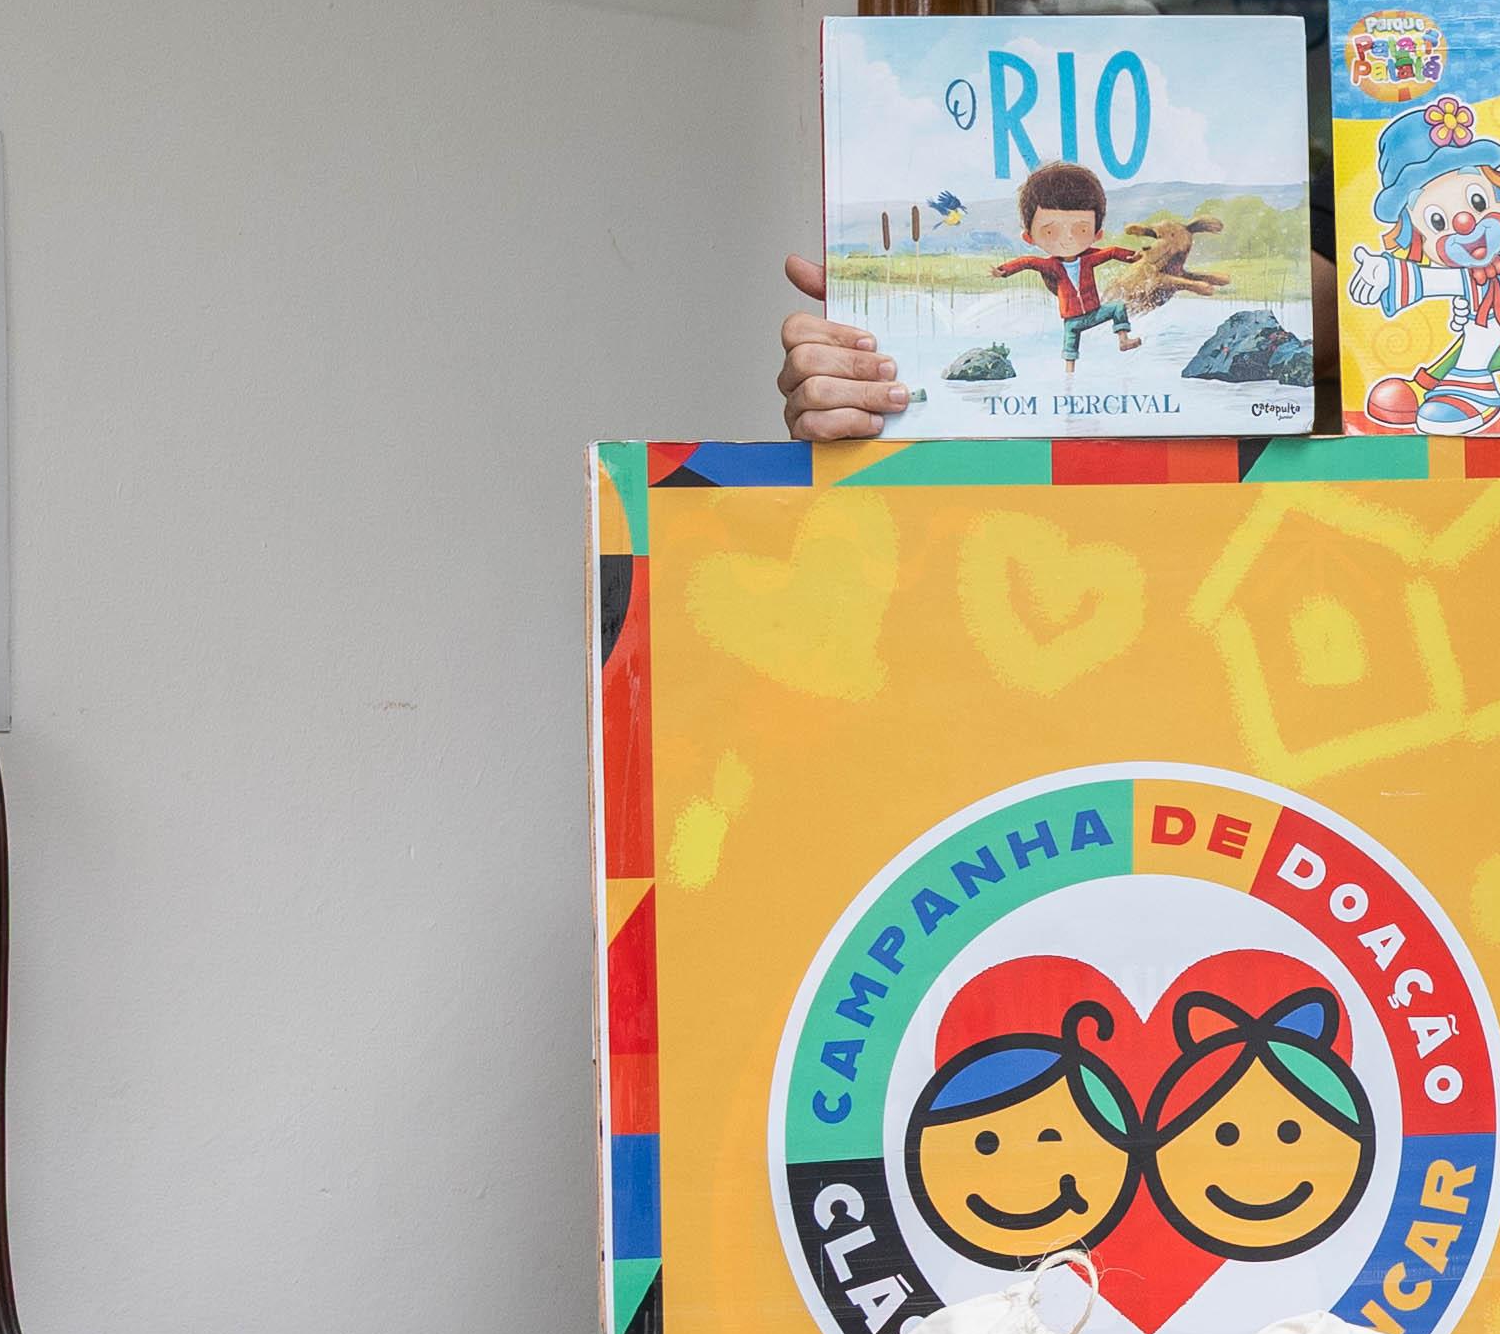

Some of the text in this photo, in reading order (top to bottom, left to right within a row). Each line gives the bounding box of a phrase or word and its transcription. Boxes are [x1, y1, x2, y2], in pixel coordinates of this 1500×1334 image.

[1365, 16, 1424, 33] Parque
[990, 49, 1153, 181] RIO
[983, 394, 1181, 416] TOM PERCIVAL
[1251, 403, 1301, 418] Catapulta
[812, 805, 1463, 1124] CAMPANHA DE DOAÇÃO
